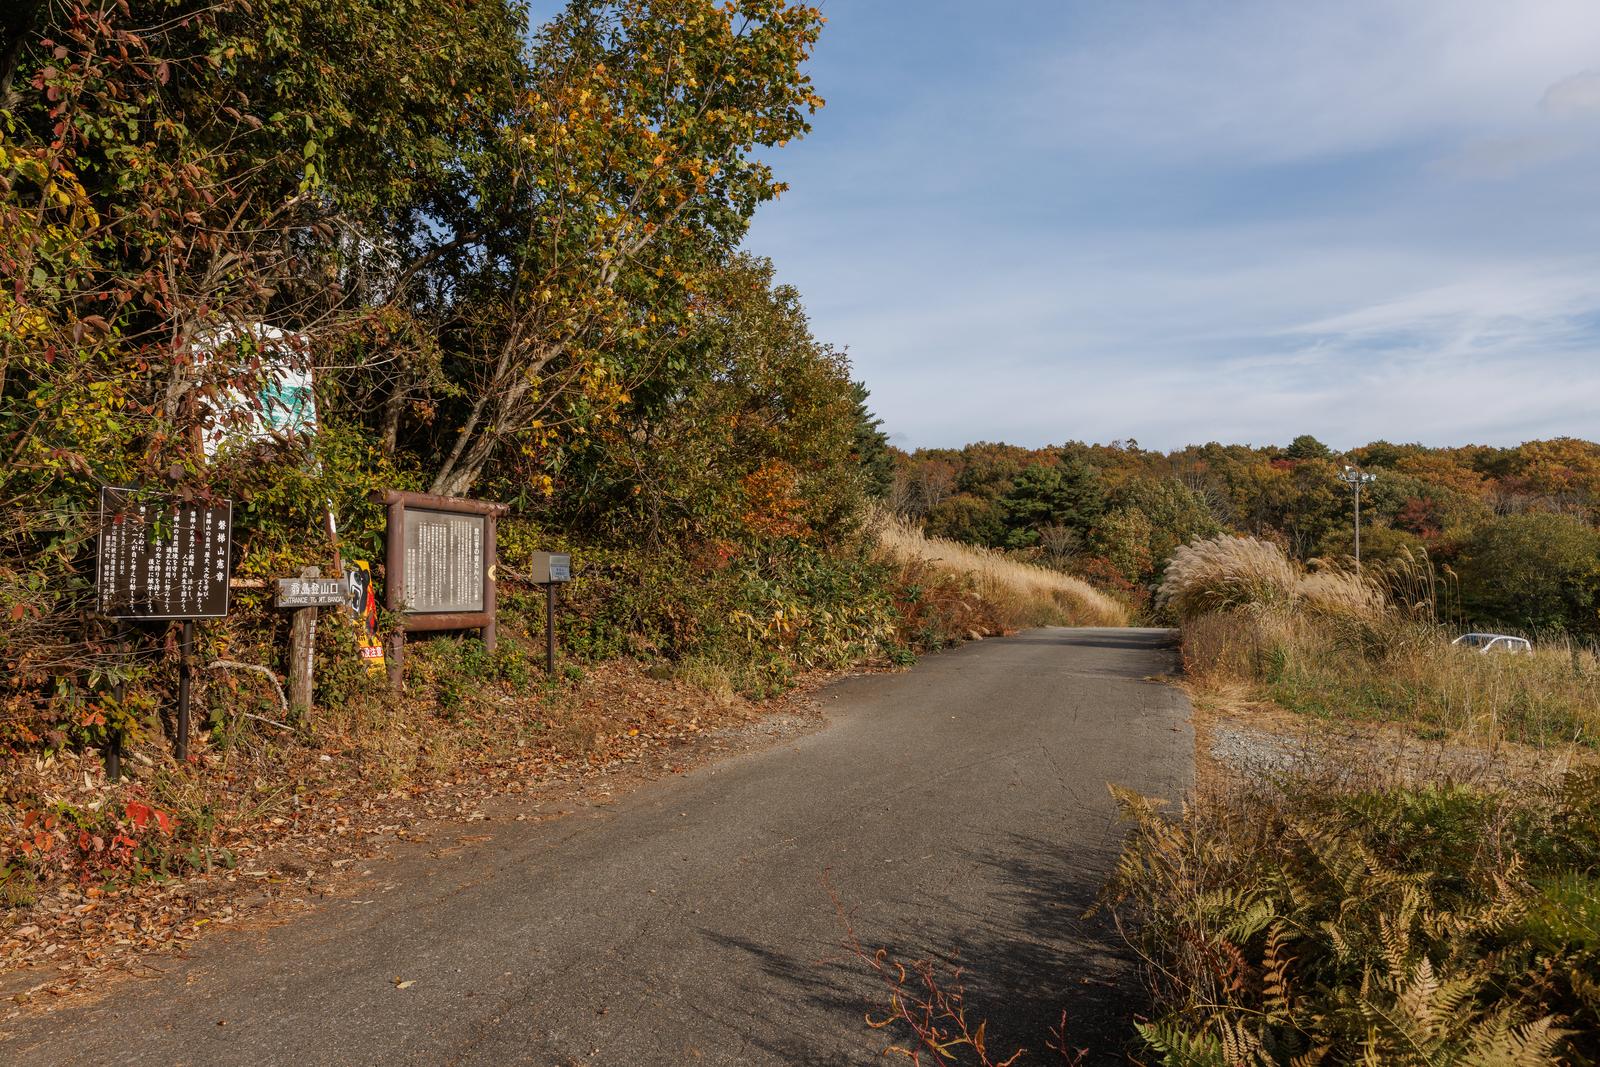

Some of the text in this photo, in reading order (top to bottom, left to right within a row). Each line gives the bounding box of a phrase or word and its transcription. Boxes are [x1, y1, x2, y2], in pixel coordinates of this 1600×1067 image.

[216, 520, 227, 582] 磐梯山憲章
[291, 583, 338, 596] 翁島登山口
[284, 596, 308, 604] TRANCE
